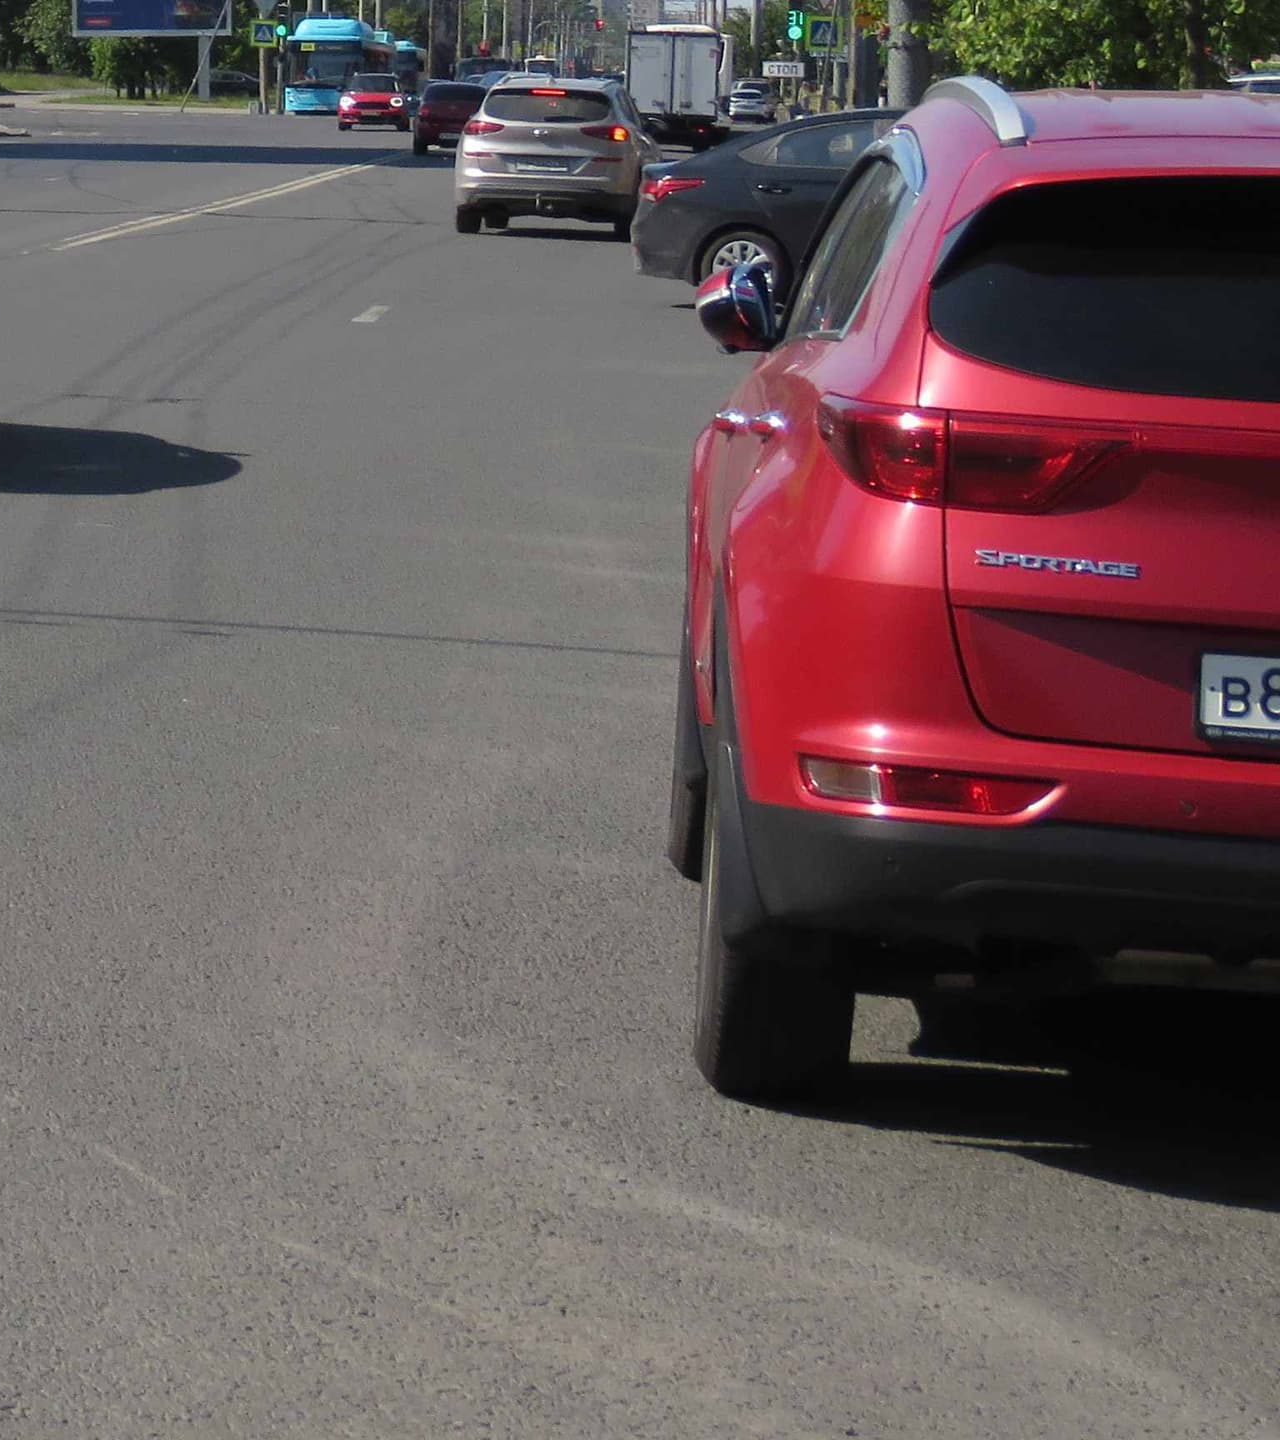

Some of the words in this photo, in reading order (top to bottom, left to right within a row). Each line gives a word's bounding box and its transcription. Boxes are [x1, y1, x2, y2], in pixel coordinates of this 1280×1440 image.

[788, 11, 803, 25] 31
[768, 64, 799, 74] СТОП
[975, 549, 1140, 578] SPORTAGE
